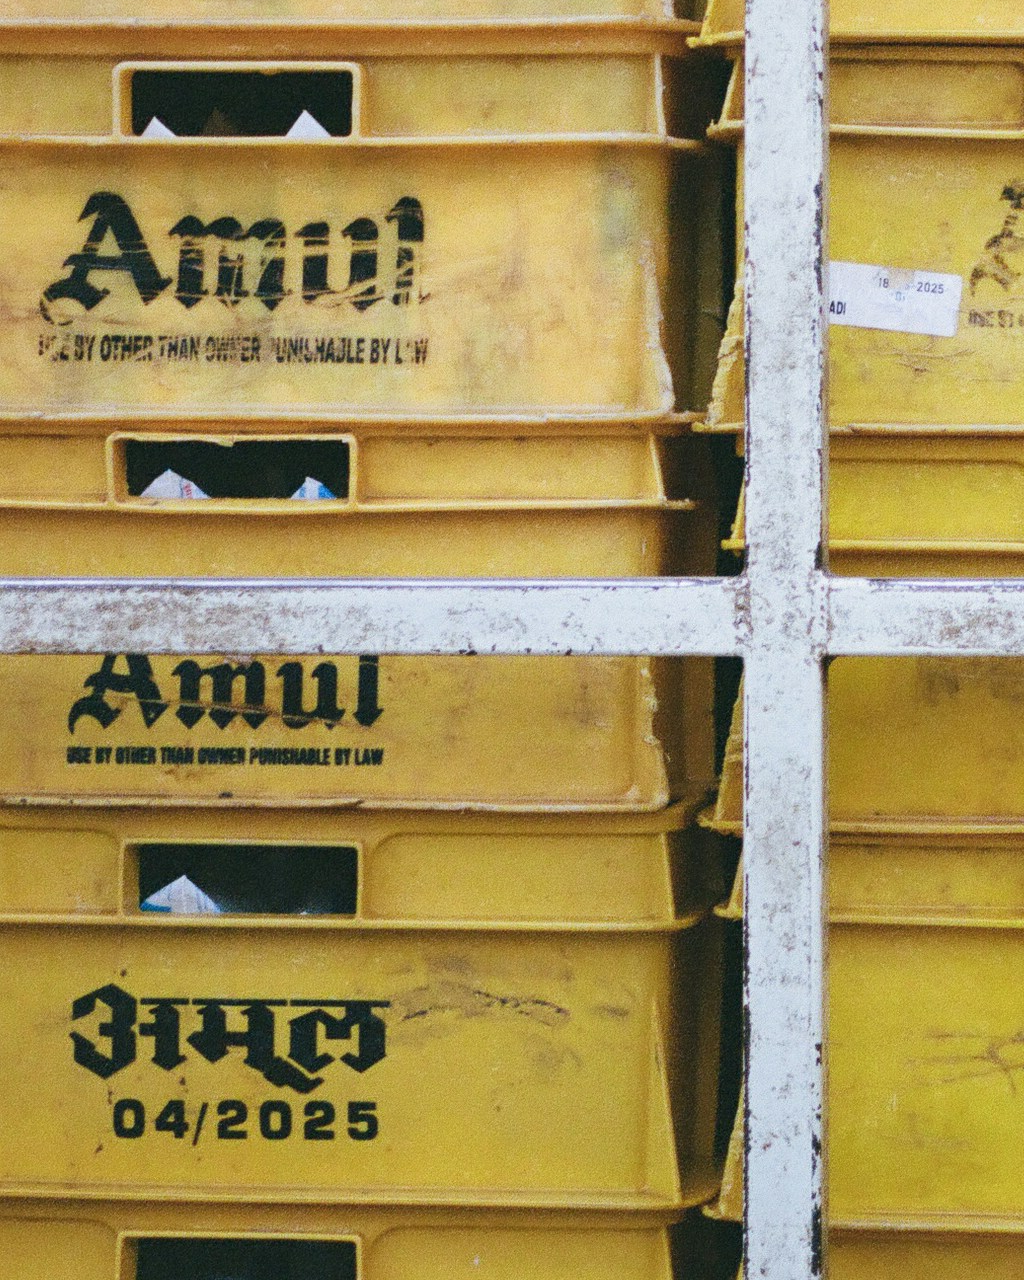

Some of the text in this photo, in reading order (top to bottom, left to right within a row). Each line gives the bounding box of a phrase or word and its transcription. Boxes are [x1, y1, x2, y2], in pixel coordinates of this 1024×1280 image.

[39, 191, 430, 326] Amul
[369, 337, 391, 364] BY
[354, 747, 385, 766] LAW
[69, 983, 391, 1095] अमूल
